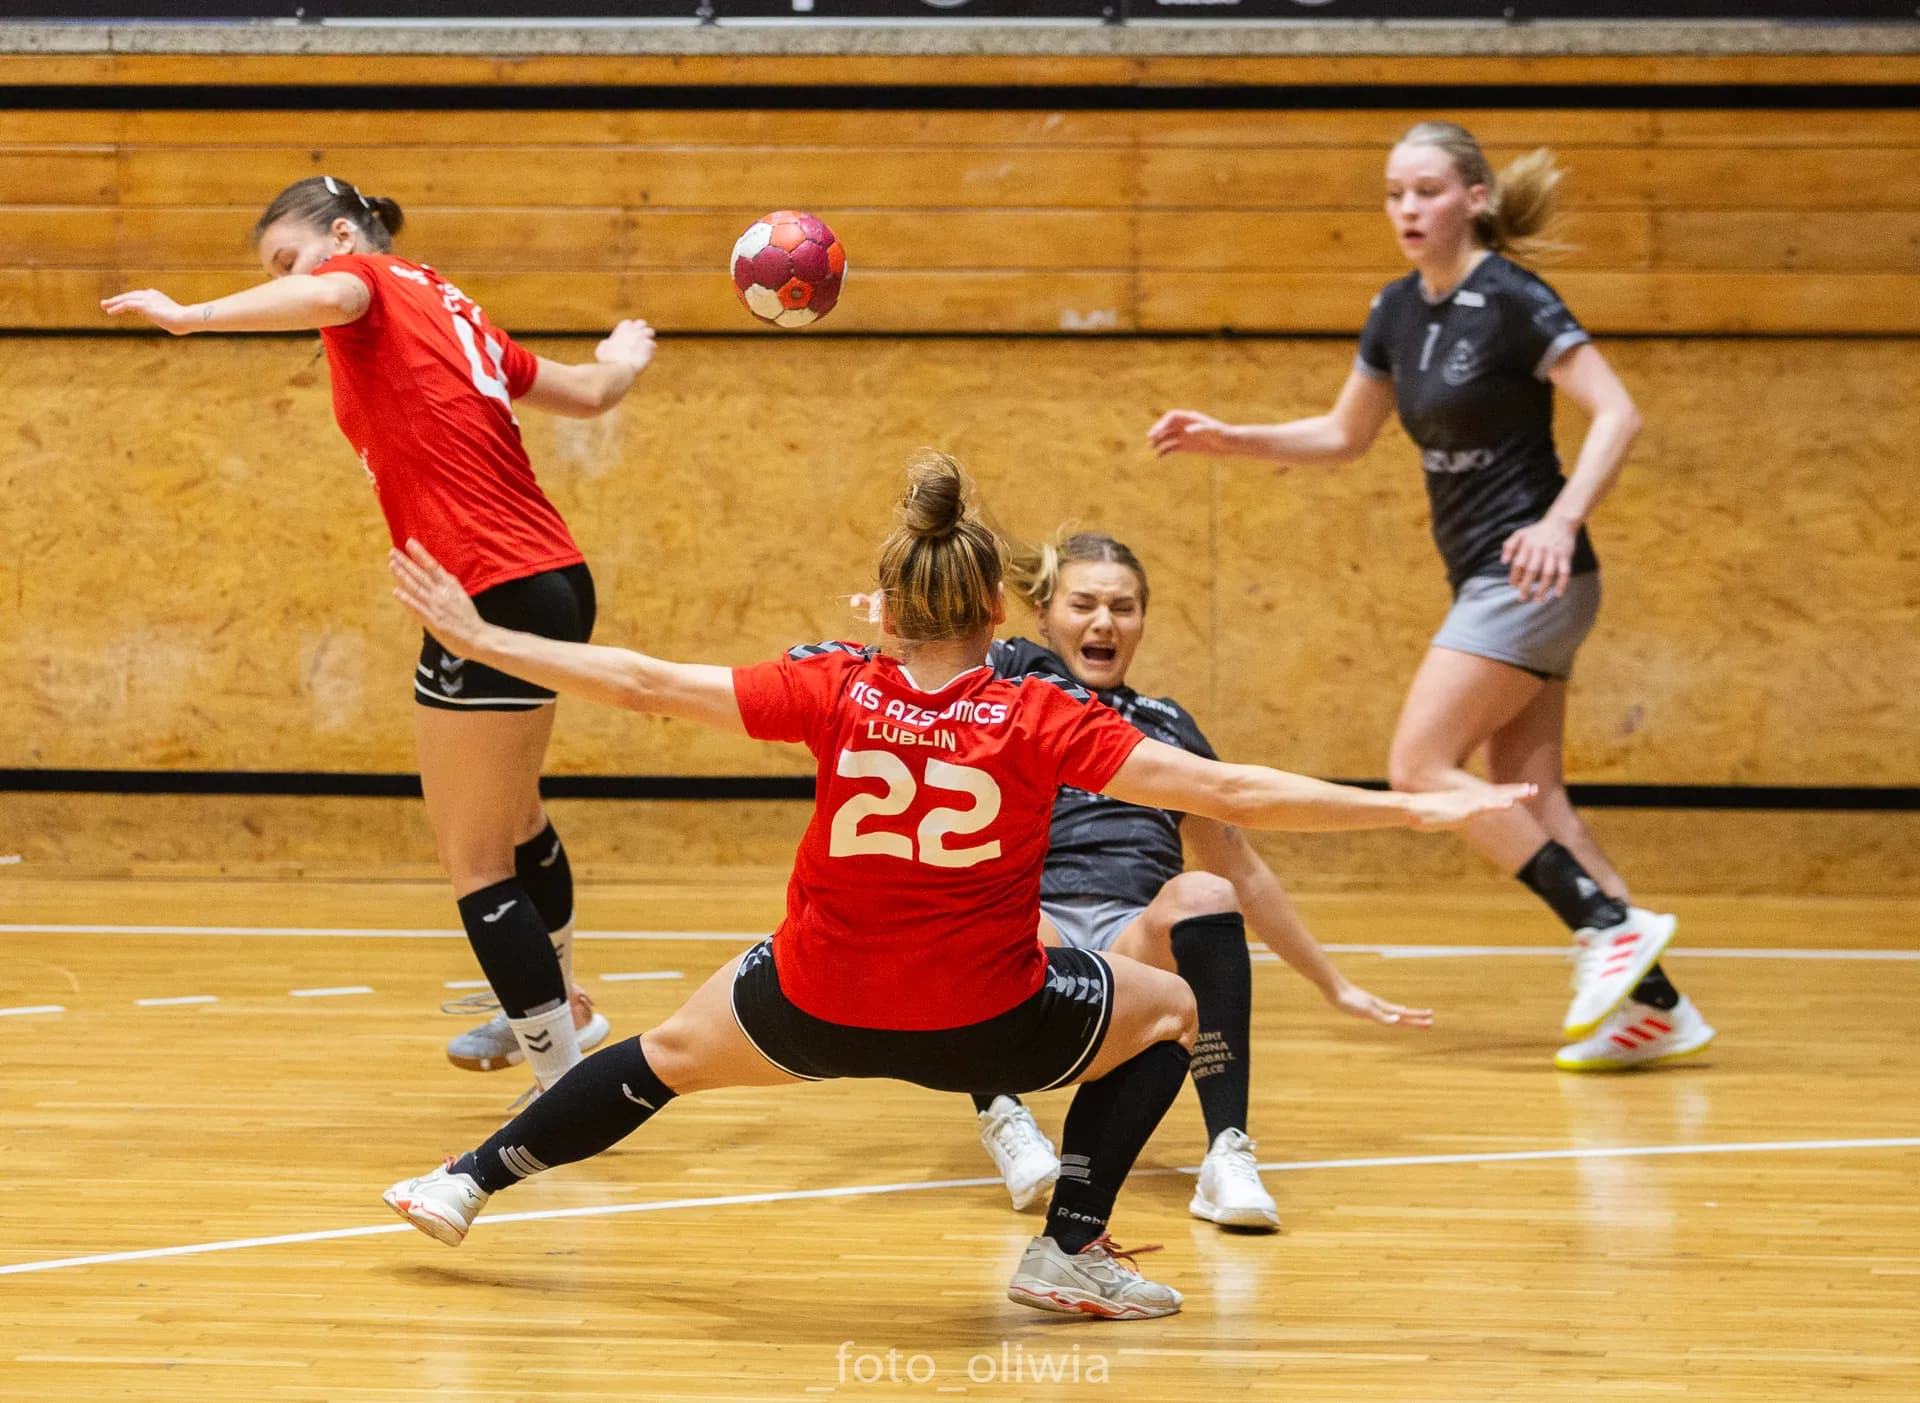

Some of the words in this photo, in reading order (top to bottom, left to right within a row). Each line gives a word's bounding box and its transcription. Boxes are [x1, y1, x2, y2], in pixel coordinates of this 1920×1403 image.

[884, 698, 938, 727] AZS
[867, 720, 956, 752] LUBLIN
[828, 748, 1002, 868] 22
